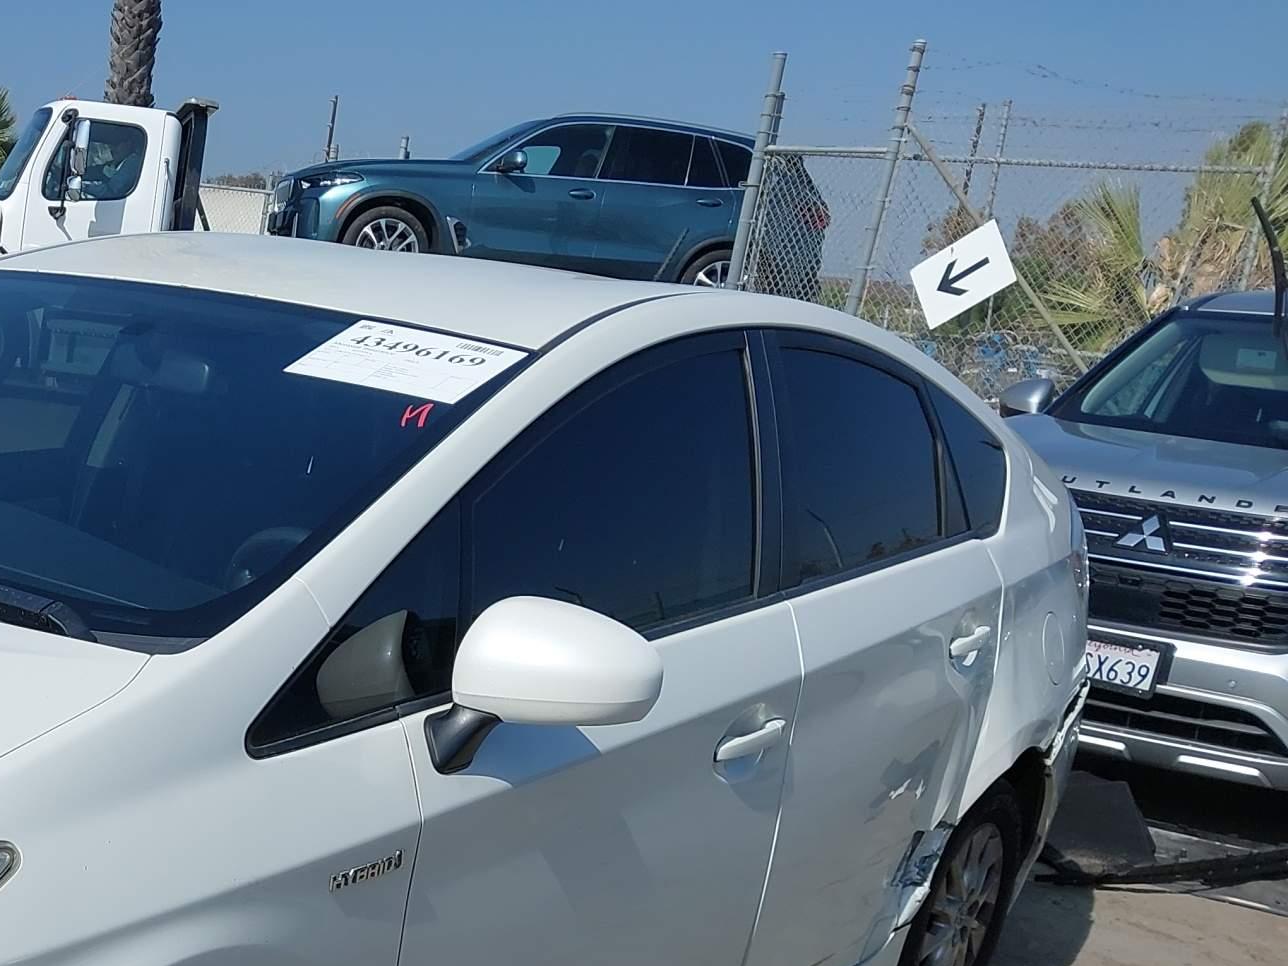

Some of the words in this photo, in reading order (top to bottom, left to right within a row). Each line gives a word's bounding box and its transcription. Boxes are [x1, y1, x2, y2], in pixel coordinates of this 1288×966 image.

[350, 334, 487, 367] 43496169
[1061, 475, 1288, 513] UTLANDE
[1085, 652, 1150, 687] SX639
[329, 849, 404, 892] HYBRID
